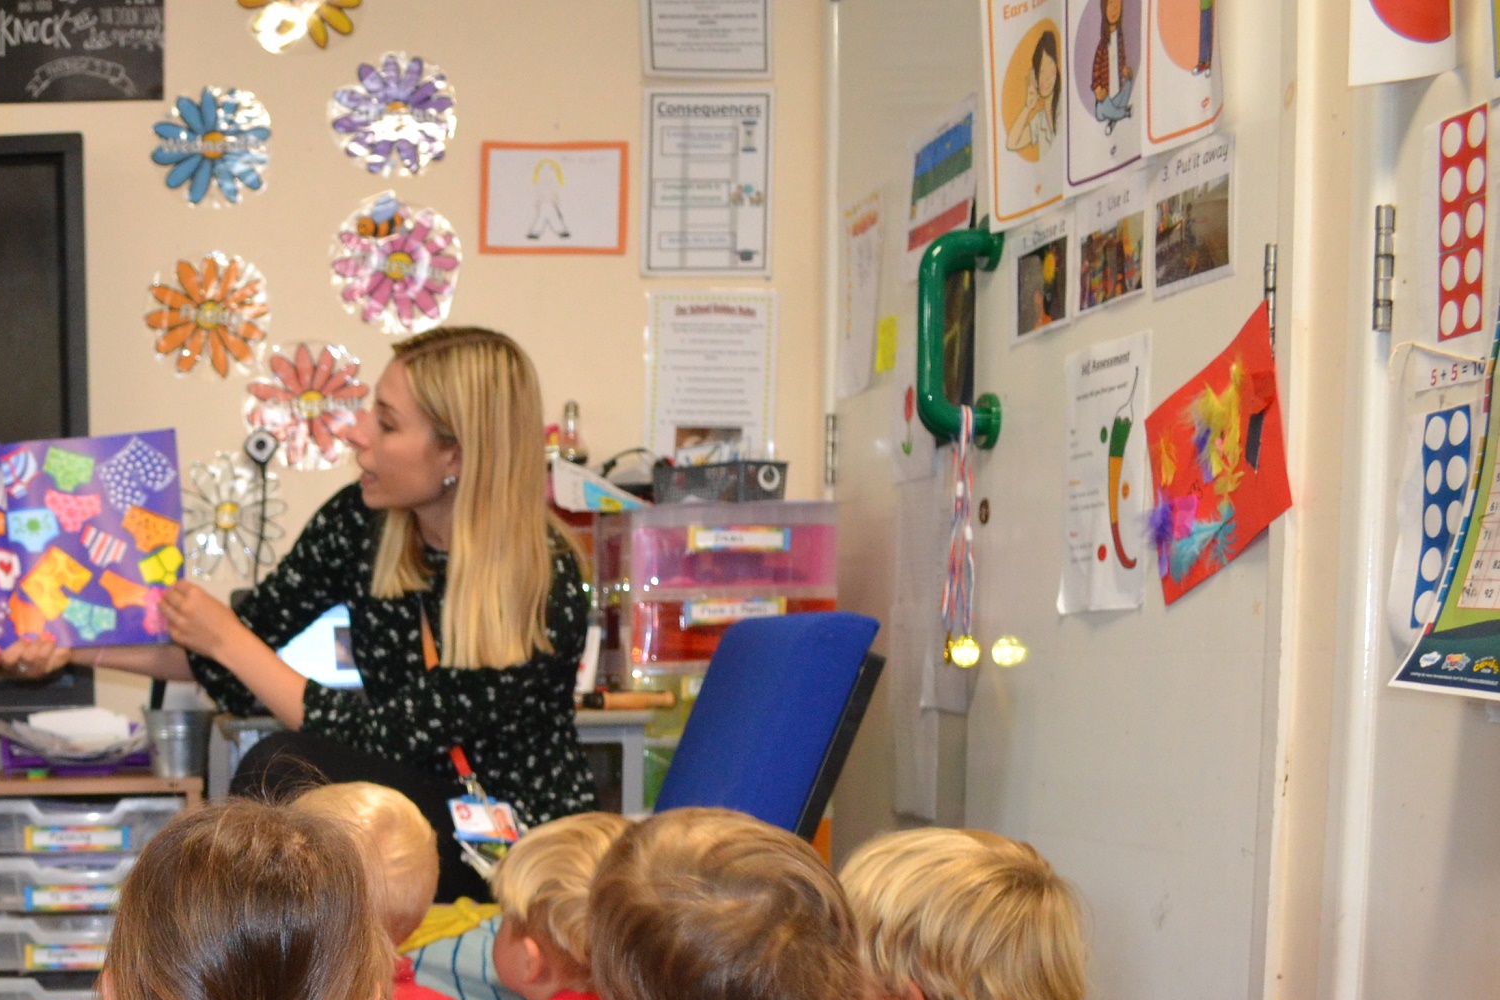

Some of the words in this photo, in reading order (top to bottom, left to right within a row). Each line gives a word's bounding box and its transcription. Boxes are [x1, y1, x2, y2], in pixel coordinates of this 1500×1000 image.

[1002, 4, 1030, 21] Ears
[657, 101, 761, 117] Consequences
[1176, 156, 1191, 175] Put
[1192, 154, 1200, 170] it
[1203, 144, 1228, 165] away
[1430, 368, 1438, 386] 5
[1451, 363, 1459, 381] 5
[1474, 559, 1484, 570] 81
[1484, 588, 1494, 599] 92
